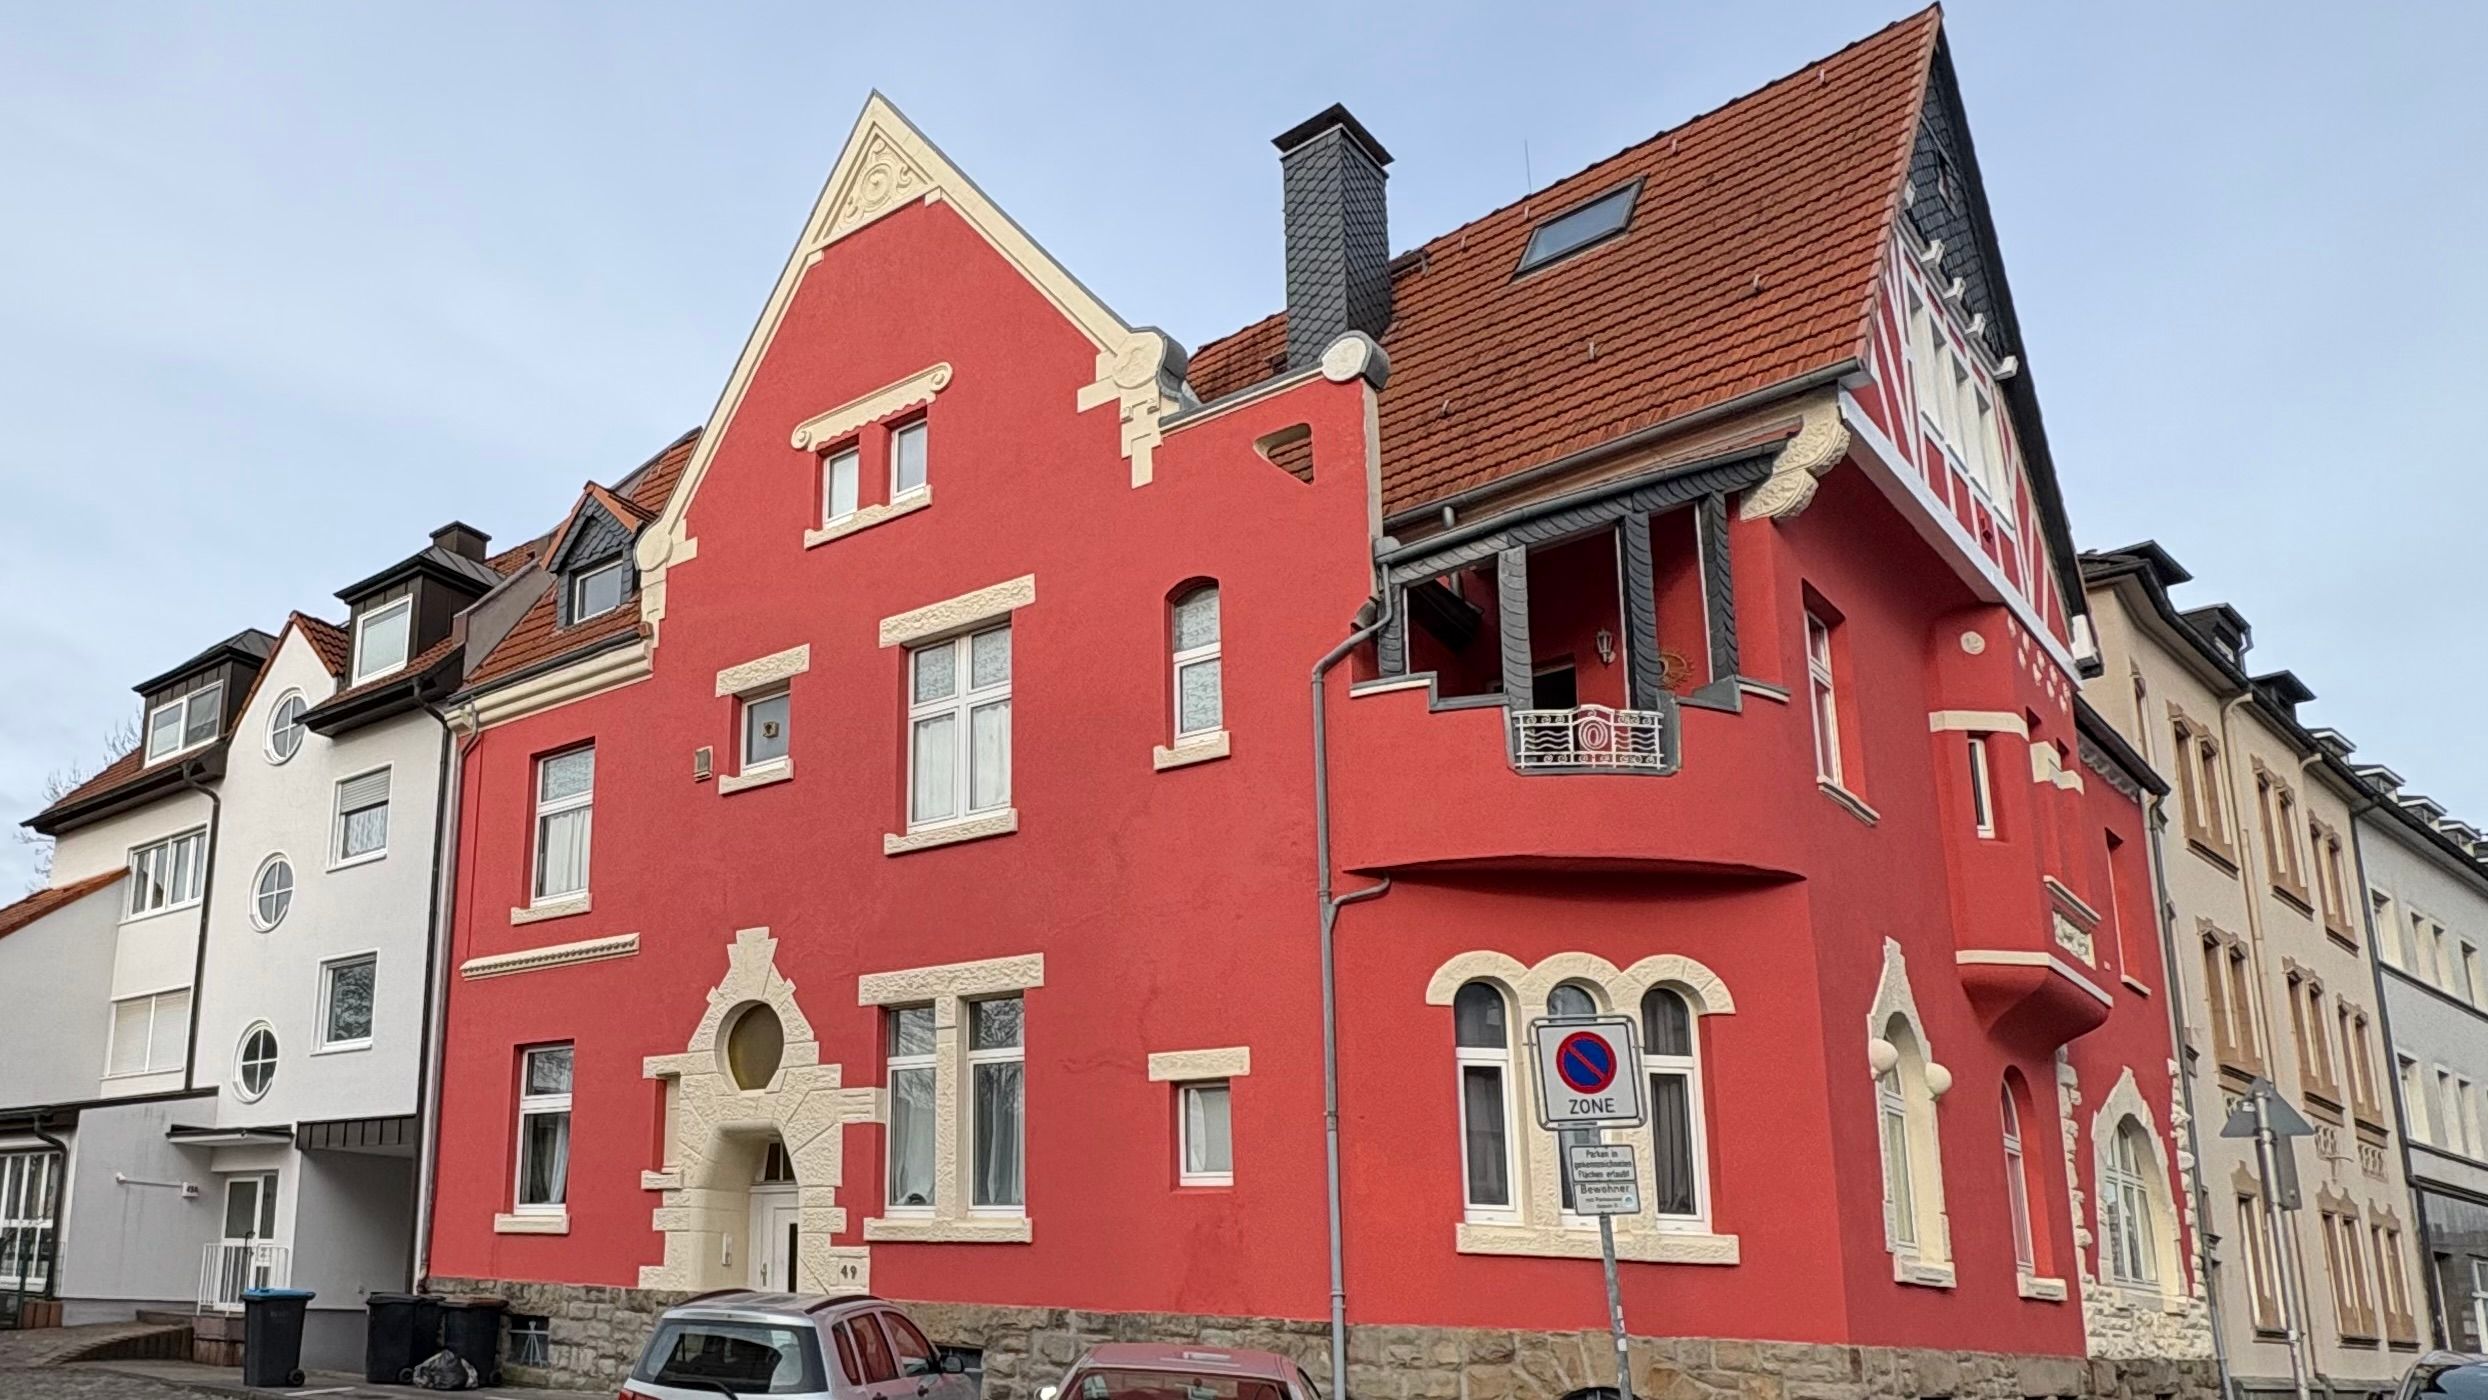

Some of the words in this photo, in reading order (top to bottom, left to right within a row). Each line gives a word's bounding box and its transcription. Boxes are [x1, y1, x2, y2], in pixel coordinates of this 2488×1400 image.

[1568, 1097, 1616, 1115] ZONE
[1585, 1149, 1609, 1158] Parken
[1611, 1150, 1618, 1158] in
[1606, 1170, 1630, 1178] erlaubt
[1580, 1184, 1629, 1194] Bewohner
[840, 1264, 857, 1280] 49
